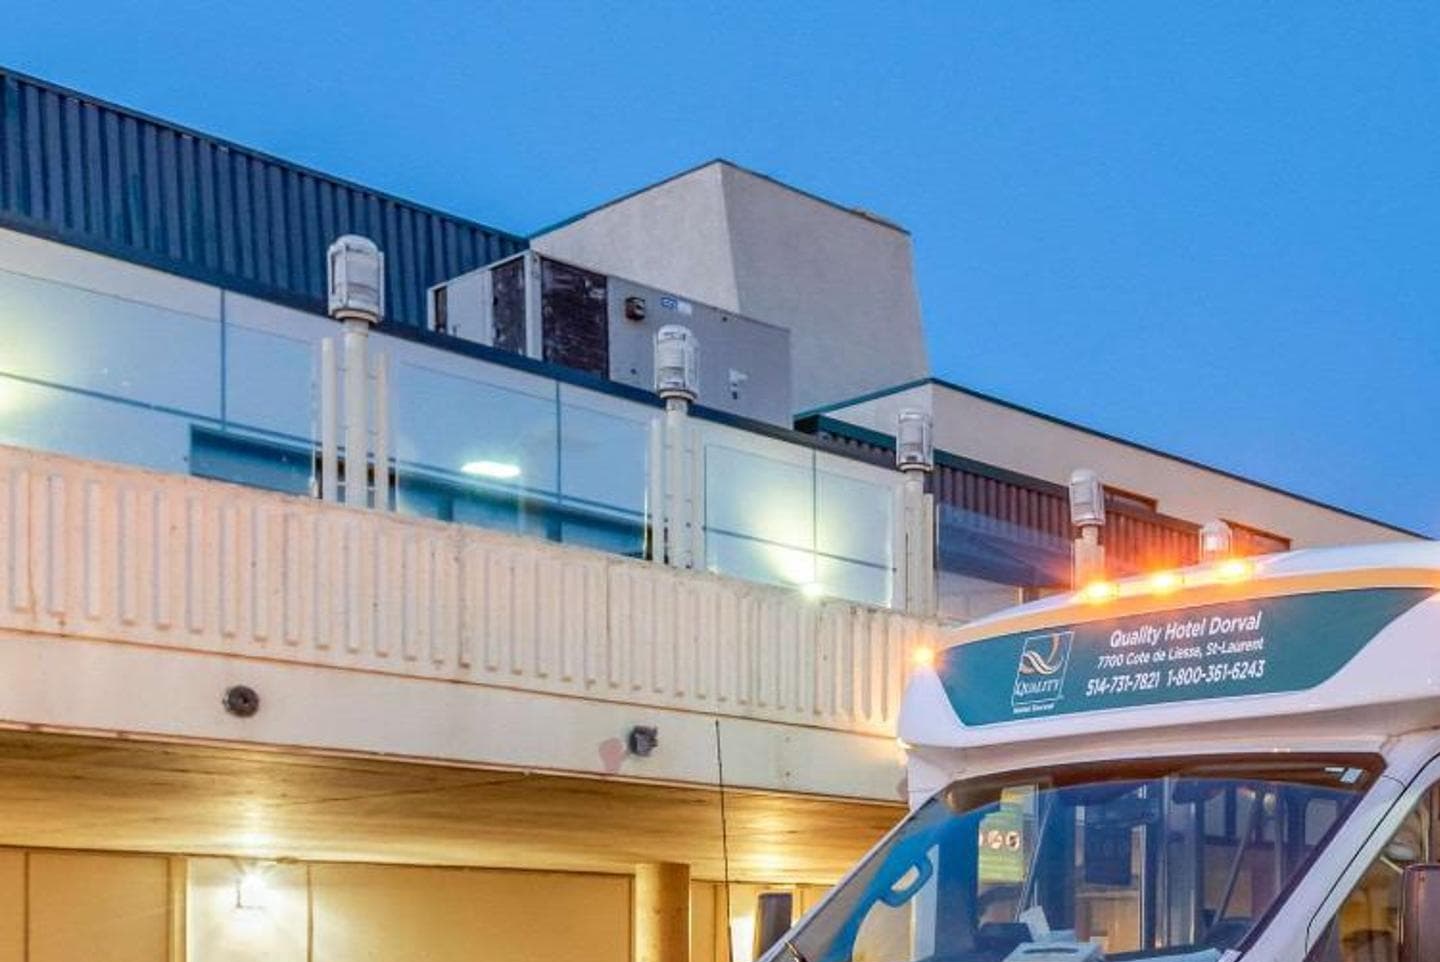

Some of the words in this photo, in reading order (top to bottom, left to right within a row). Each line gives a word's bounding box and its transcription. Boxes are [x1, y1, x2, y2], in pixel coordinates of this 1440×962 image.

[1110, 625, 1161, 648] Quality
[1164, 618, 1207, 641] Hotel
[1208, 611, 1263, 635] Dorval
[1097, 655, 1124, 669] 7700
[1126, 652, 1151, 665] Cote
[1152, 649, 1166, 662] de
[1206, 637, 1264, 656] St-Laurent
[1086, 671, 1160, 696] 514-731-7821
[1166, 660, 1265, 687] 1-800-361-6243
